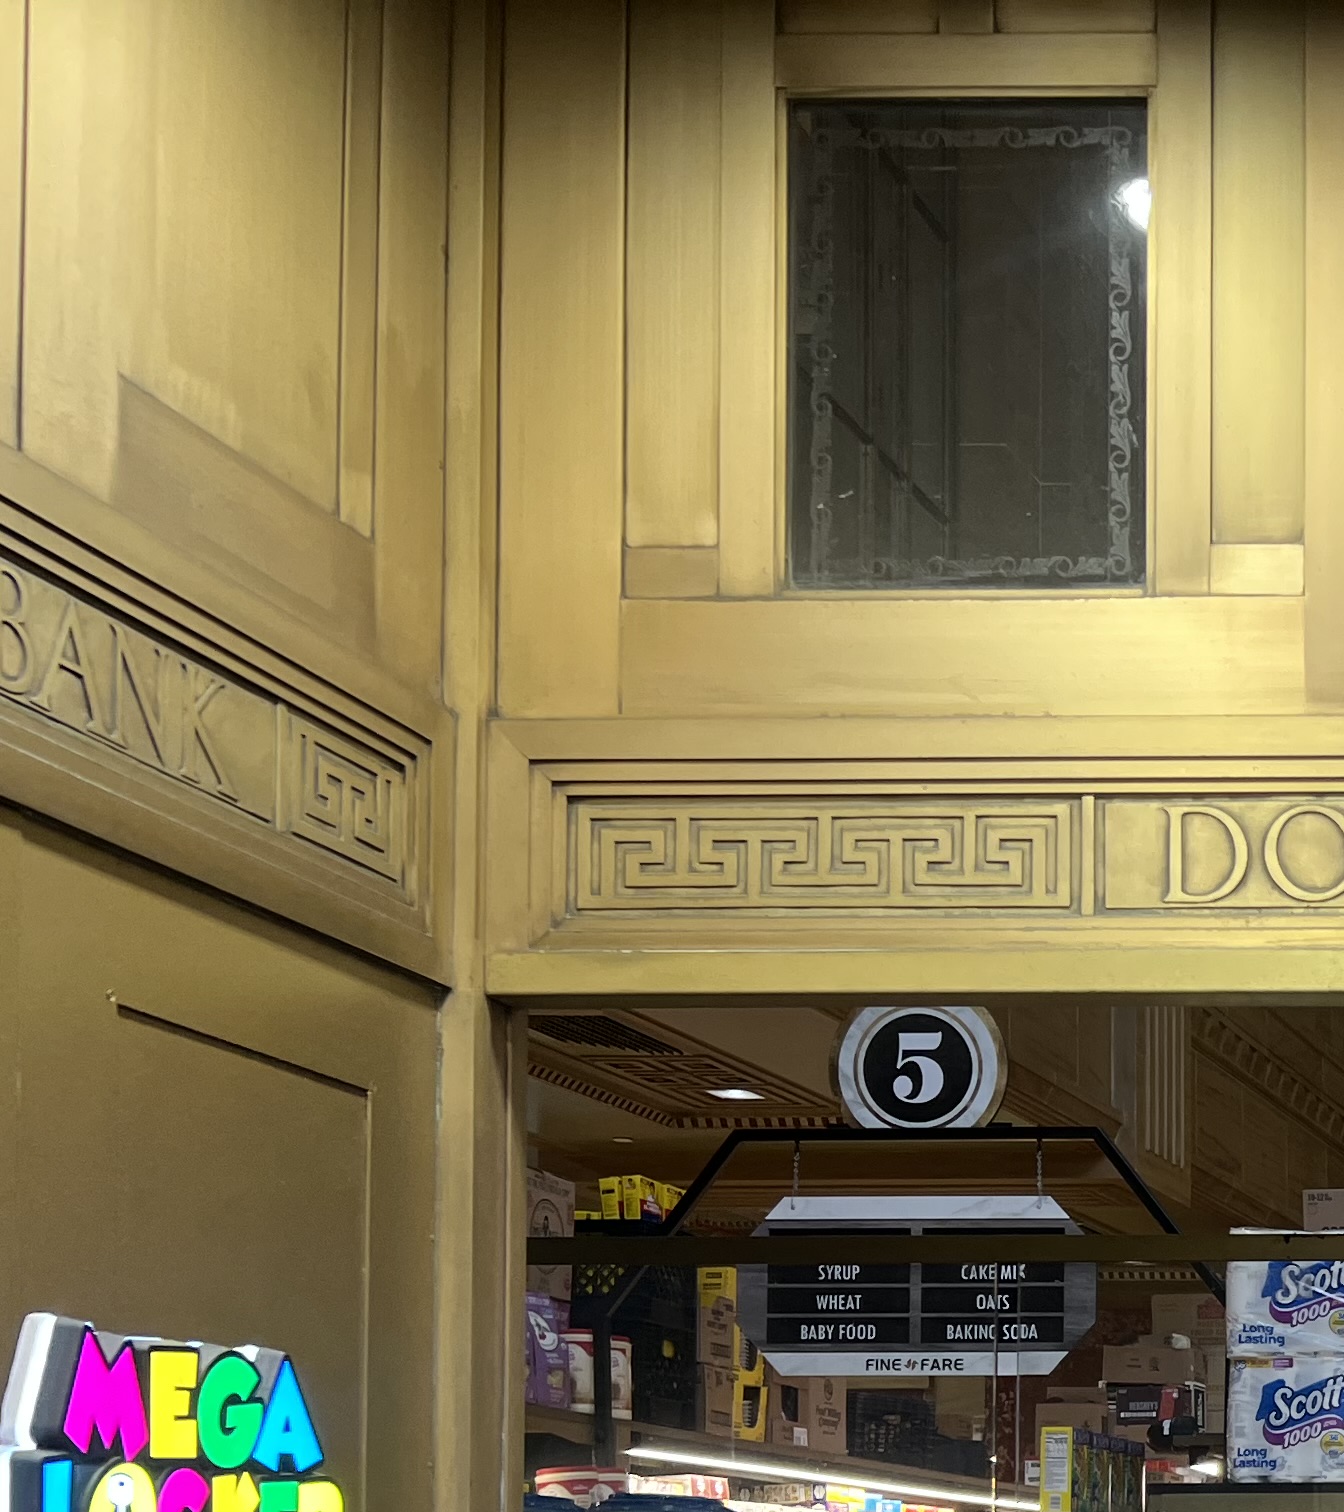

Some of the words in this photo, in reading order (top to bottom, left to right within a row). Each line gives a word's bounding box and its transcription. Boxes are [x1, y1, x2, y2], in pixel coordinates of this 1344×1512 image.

[0, 566, 239, 803] BANK
[891, 1031, 945, 1103] 5
[817, 1264, 861, 1281] SYRUP
[961, 1264, 996, 1281] CAKE
[816, 1294, 862, 1311] WHEAT
[976, 1294, 1010, 1310] OATS
[1290, 1300, 1331, 1327] 1000
[800, 1324, 834, 1341] BABY
[838, 1323, 877, 1340] FOOD
[1002, 1323, 1038, 1340] SODA
[1242, 1323, 1275, 1336] Long
[1237, 1333, 1286, 1347] Lasting
[865, 1358, 902, 1372] FINE
[920, 1357, 965, 1371] FARE
[64, 1331, 325, 1474] MEGA
[1282, 1422, 1322, 1449] 1000
[1237, 1447, 1268, 1459] Long
[1233, 1457, 1277, 1471] Lasting
